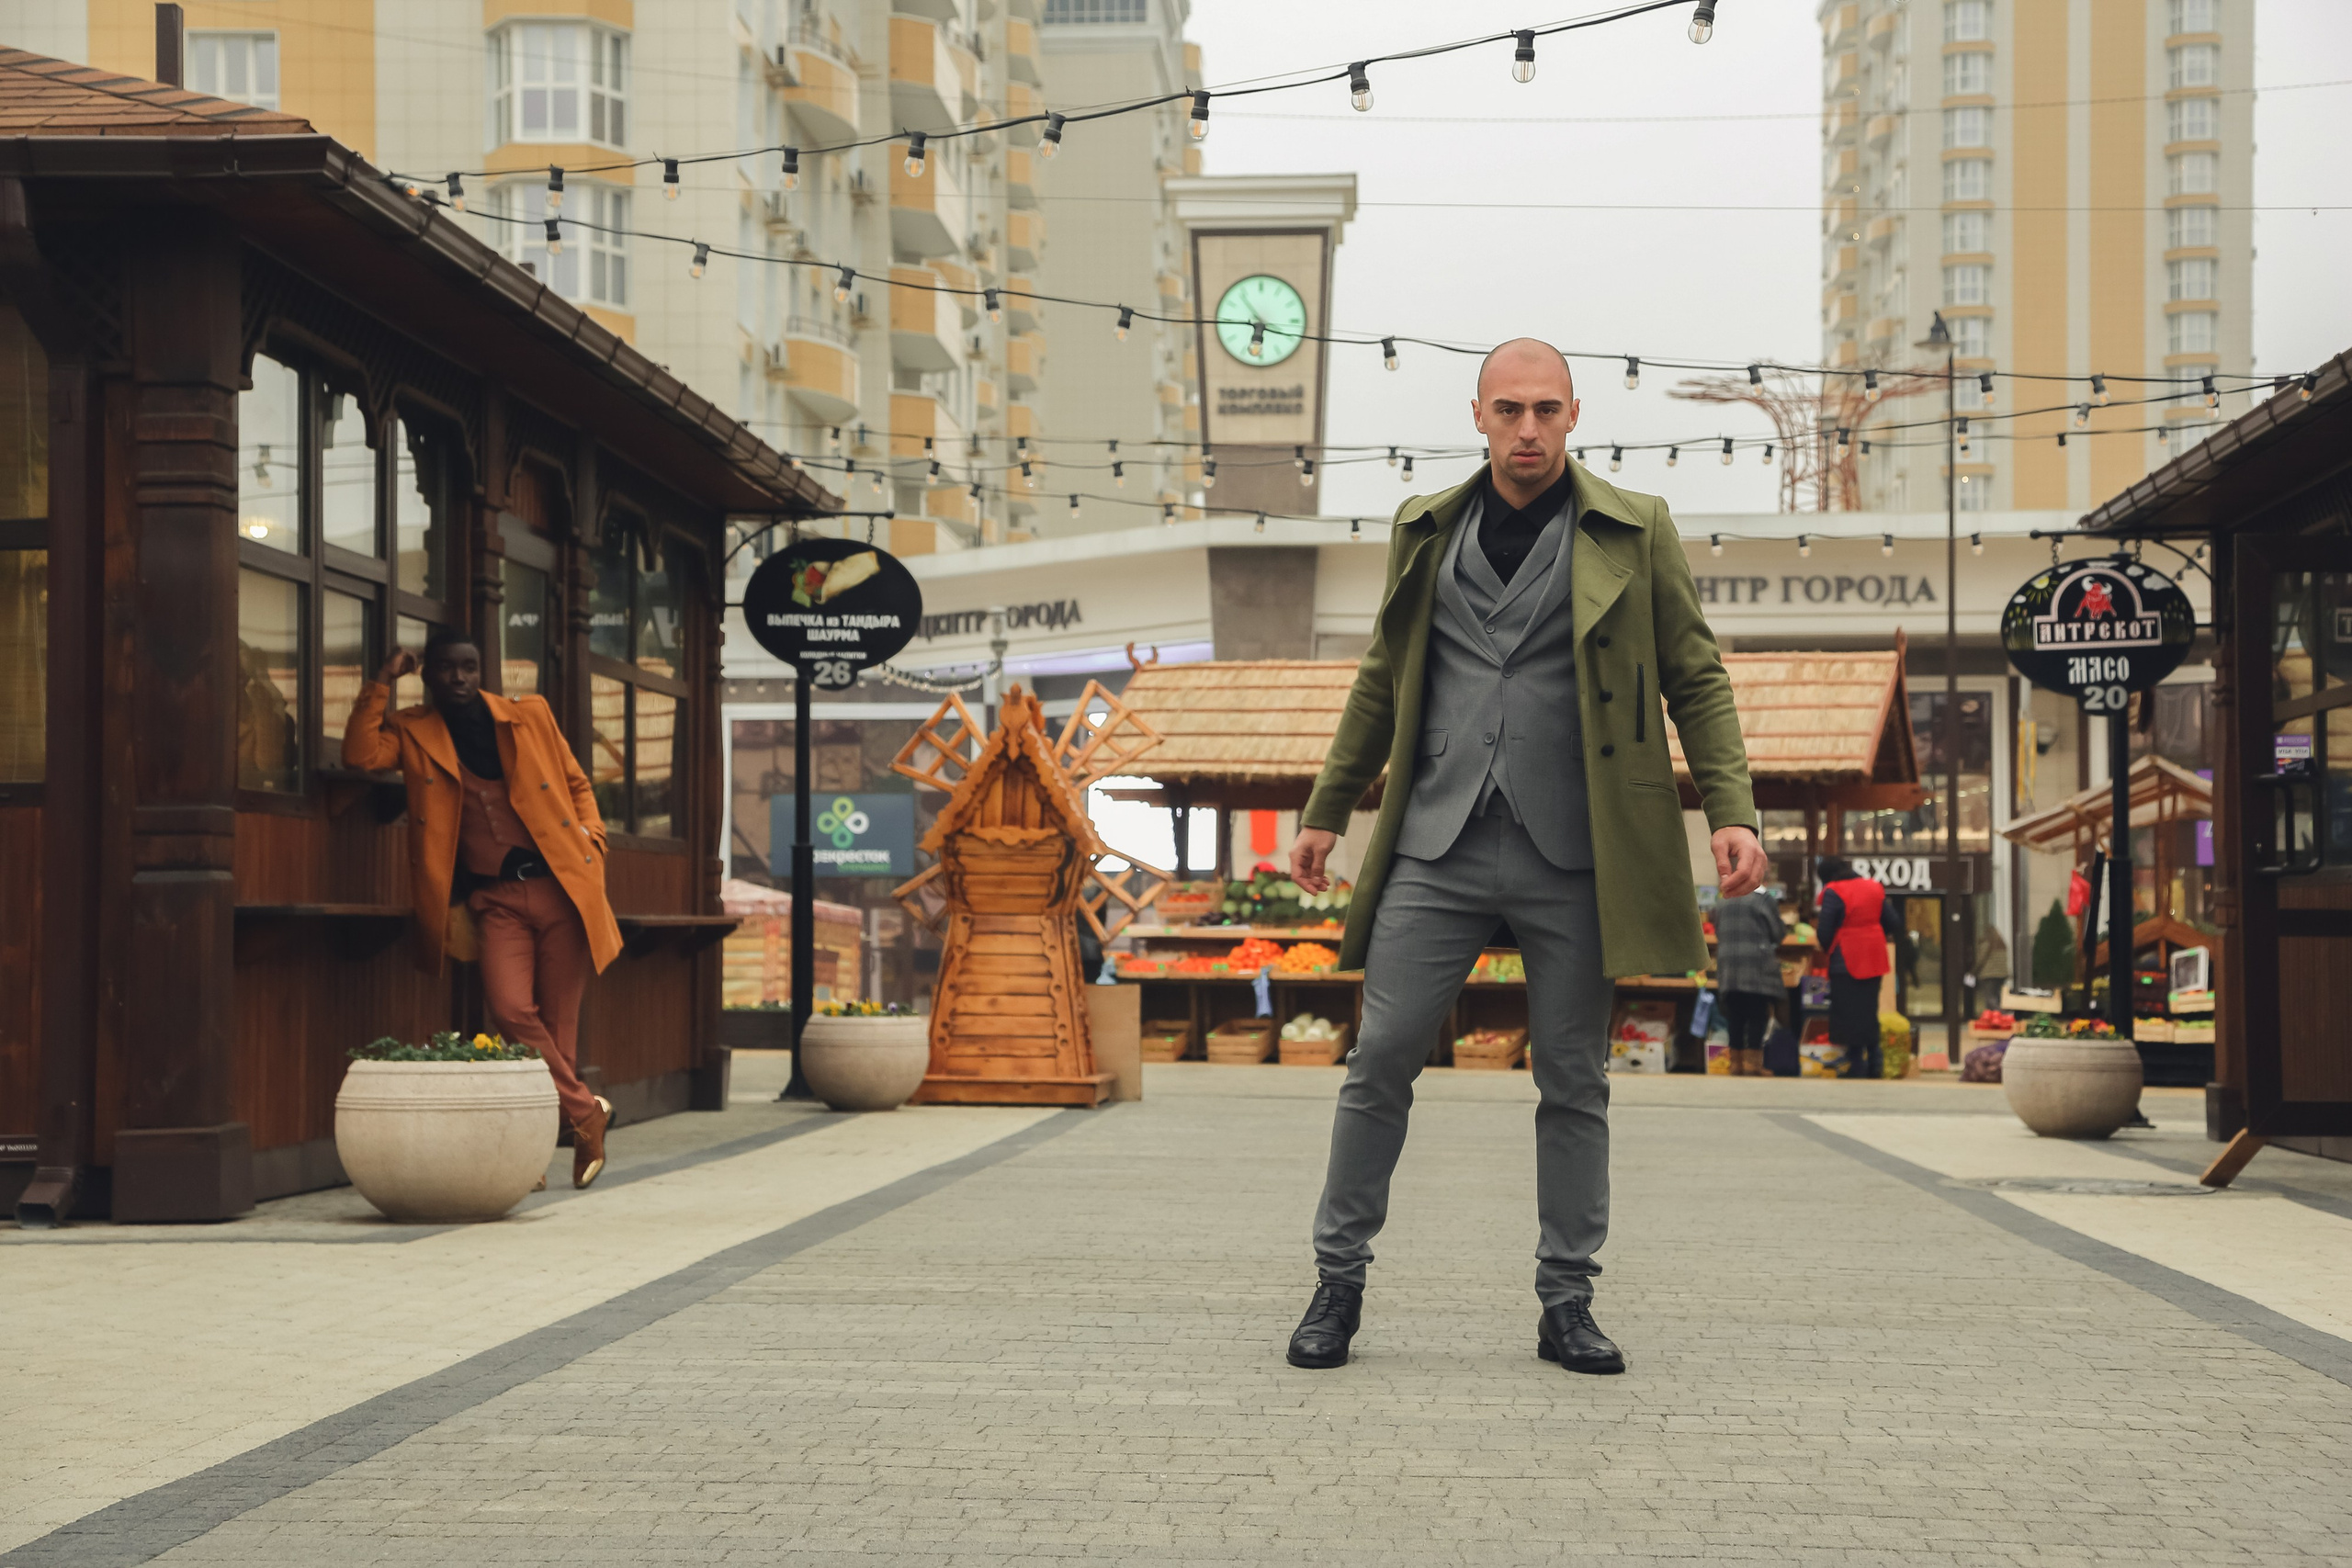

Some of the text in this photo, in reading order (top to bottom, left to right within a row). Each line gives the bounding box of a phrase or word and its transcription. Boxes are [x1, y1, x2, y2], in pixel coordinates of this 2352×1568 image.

[1694, 574, 1938, 607] НТР ГОРОДА
[766, 614, 901, 629] ВЫПЕЧКА из ТАНДЫРА
[1004, 599, 1082, 631] ОРОДА
[806, 628, 861, 641] ШАУРМА
[813, 660, 852, 685] 26
[2067, 655, 2131, 684] МЯСО
[2084, 685, 2128, 710] 20
[1851, 857, 1932, 891] ВХОД
